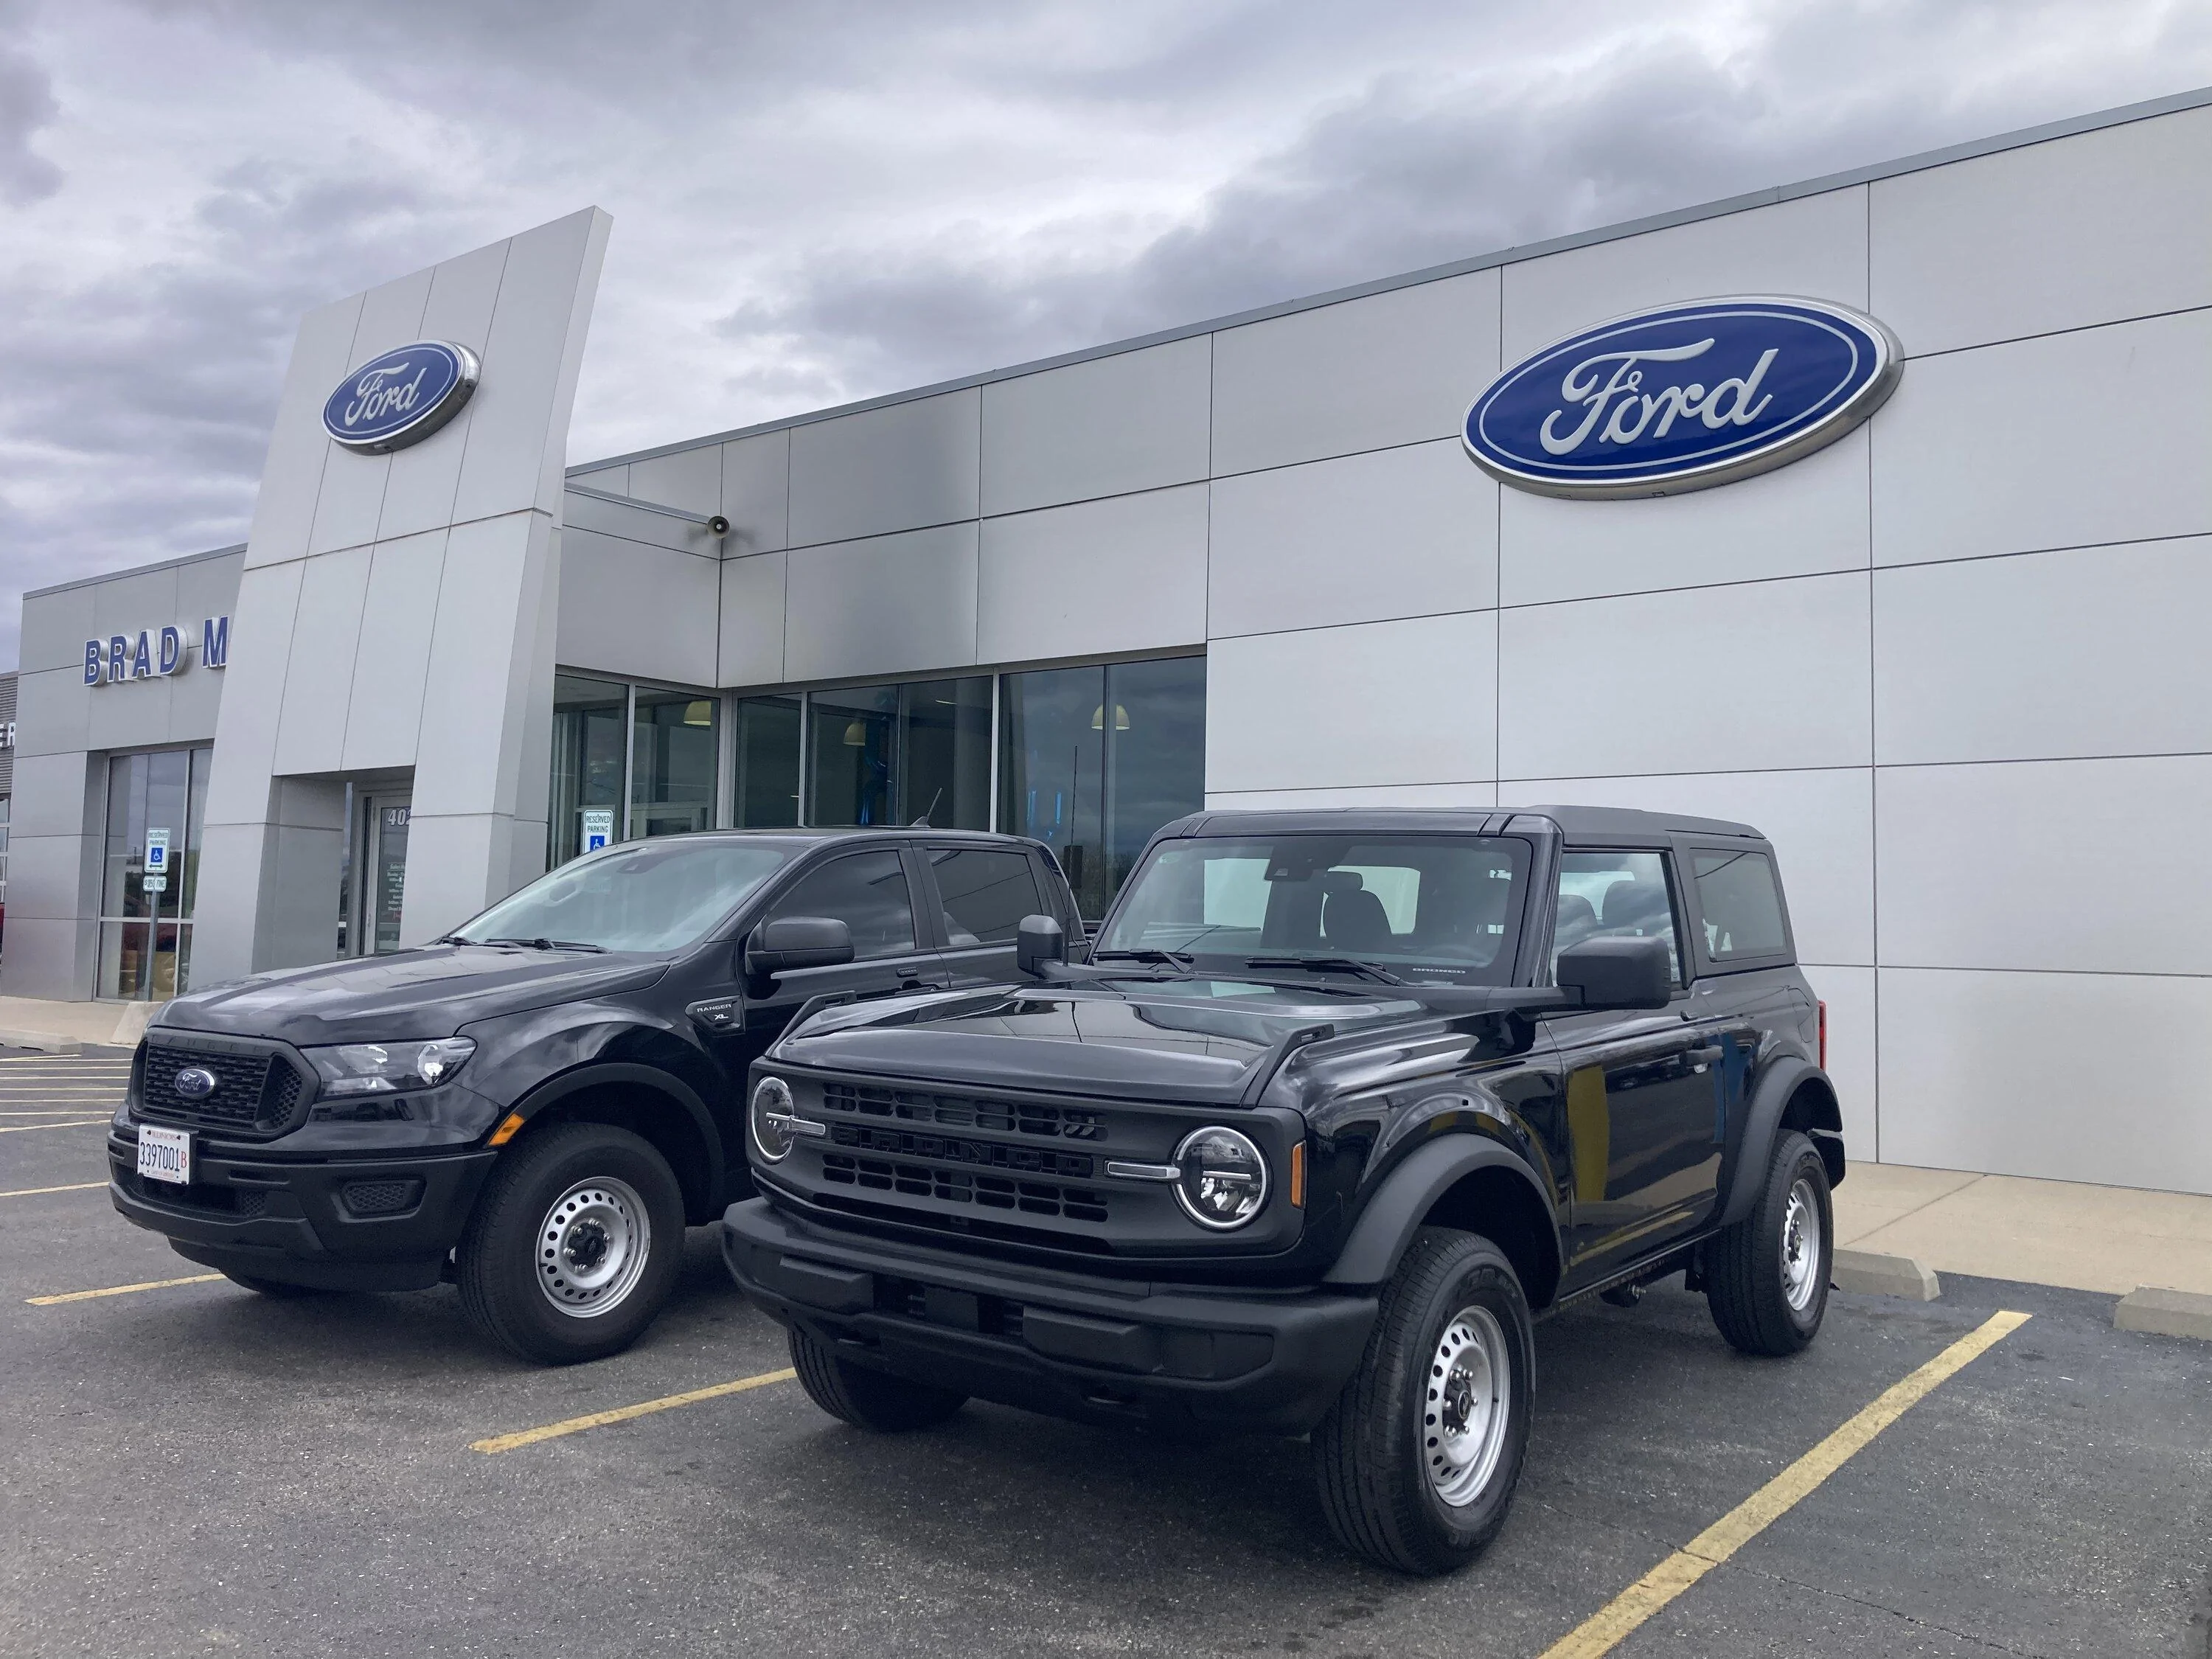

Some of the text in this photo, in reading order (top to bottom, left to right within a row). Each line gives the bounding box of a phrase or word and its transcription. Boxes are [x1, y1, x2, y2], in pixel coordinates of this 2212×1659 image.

[344, 362, 428, 427] Ford
[1539, 337, 1779, 456] Ford
[83, 625, 185, 686] BRAD
[585, 815, 611, 823] RESERVED
[696, 1004, 732, 1012] RANGER
[179, 1072, 202, 1091] Ford
[830, 1124, 1094, 1178] BRONCO
